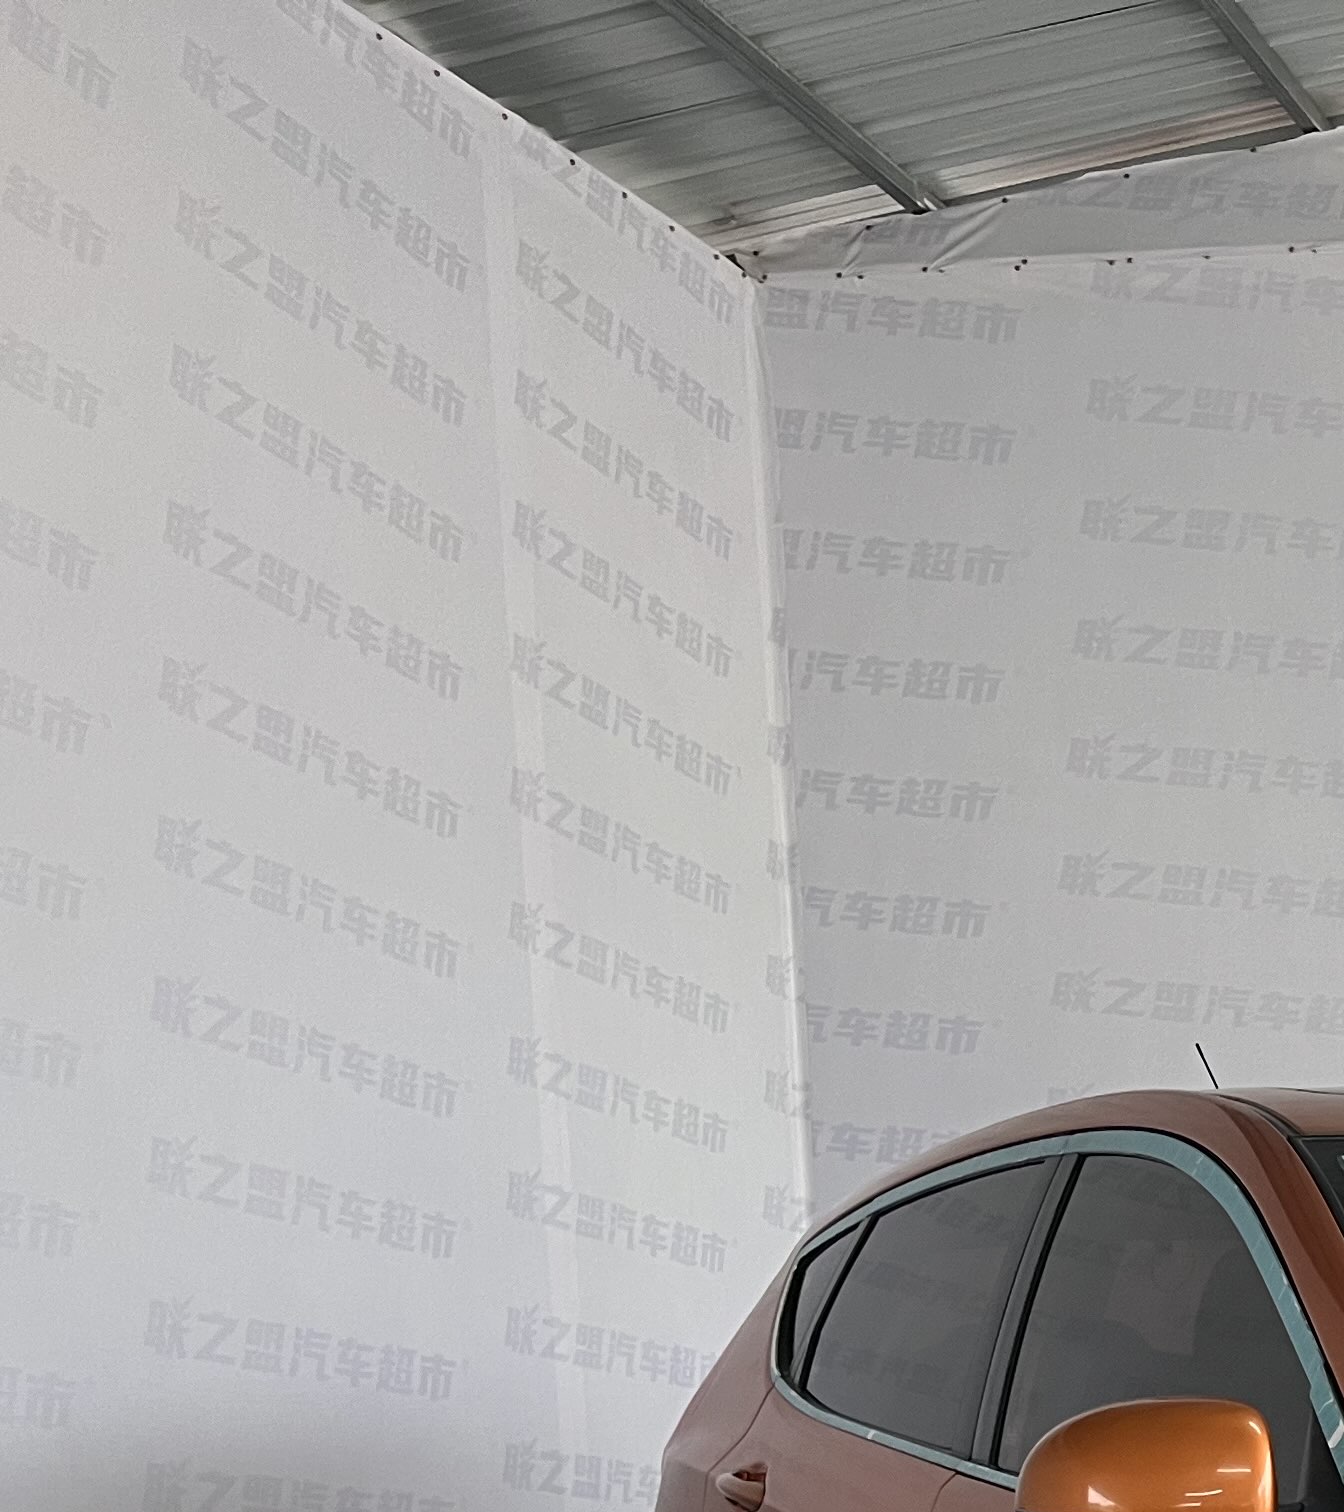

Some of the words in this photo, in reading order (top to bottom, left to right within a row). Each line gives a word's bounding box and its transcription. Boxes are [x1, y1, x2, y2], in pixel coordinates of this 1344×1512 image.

[179, 36, 470, 293] 联之盟汽车超市
[174, 189, 466, 427] 联之盟汽车超市
[517, 238, 735, 442] 联之盟汽车超市
[169, 343, 463, 563] 联之盟汽车超市
[514, 368, 734, 560] 联之盟汽车超市
[163, 499, 463, 702] 联之盟汽车超市
[512, 499, 734, 678] 联之盟汽车超市
[157, 655, 461, 839] 联之盟汽车超市
[511, 633, 733, 797] 联之盟汽车超市
[153, 815, 459, 979] 联之盟汽车超市
[509, 765, 732, 915] 联之盟汽车超市
[149, 975, 458, 1119] 联之盟汽车超市
[507, 901, 729, 1034] 联之盟汽车超市
[507, 1035, 730, 1153] 联之盟汽车超市
[146, 1135, 457, 1260] 联之盟汽车超市
[506, 1168, 727, 1273] 联之盟汽车超市
[143, 1296, 456, 1401] 联之盟汽车超市
